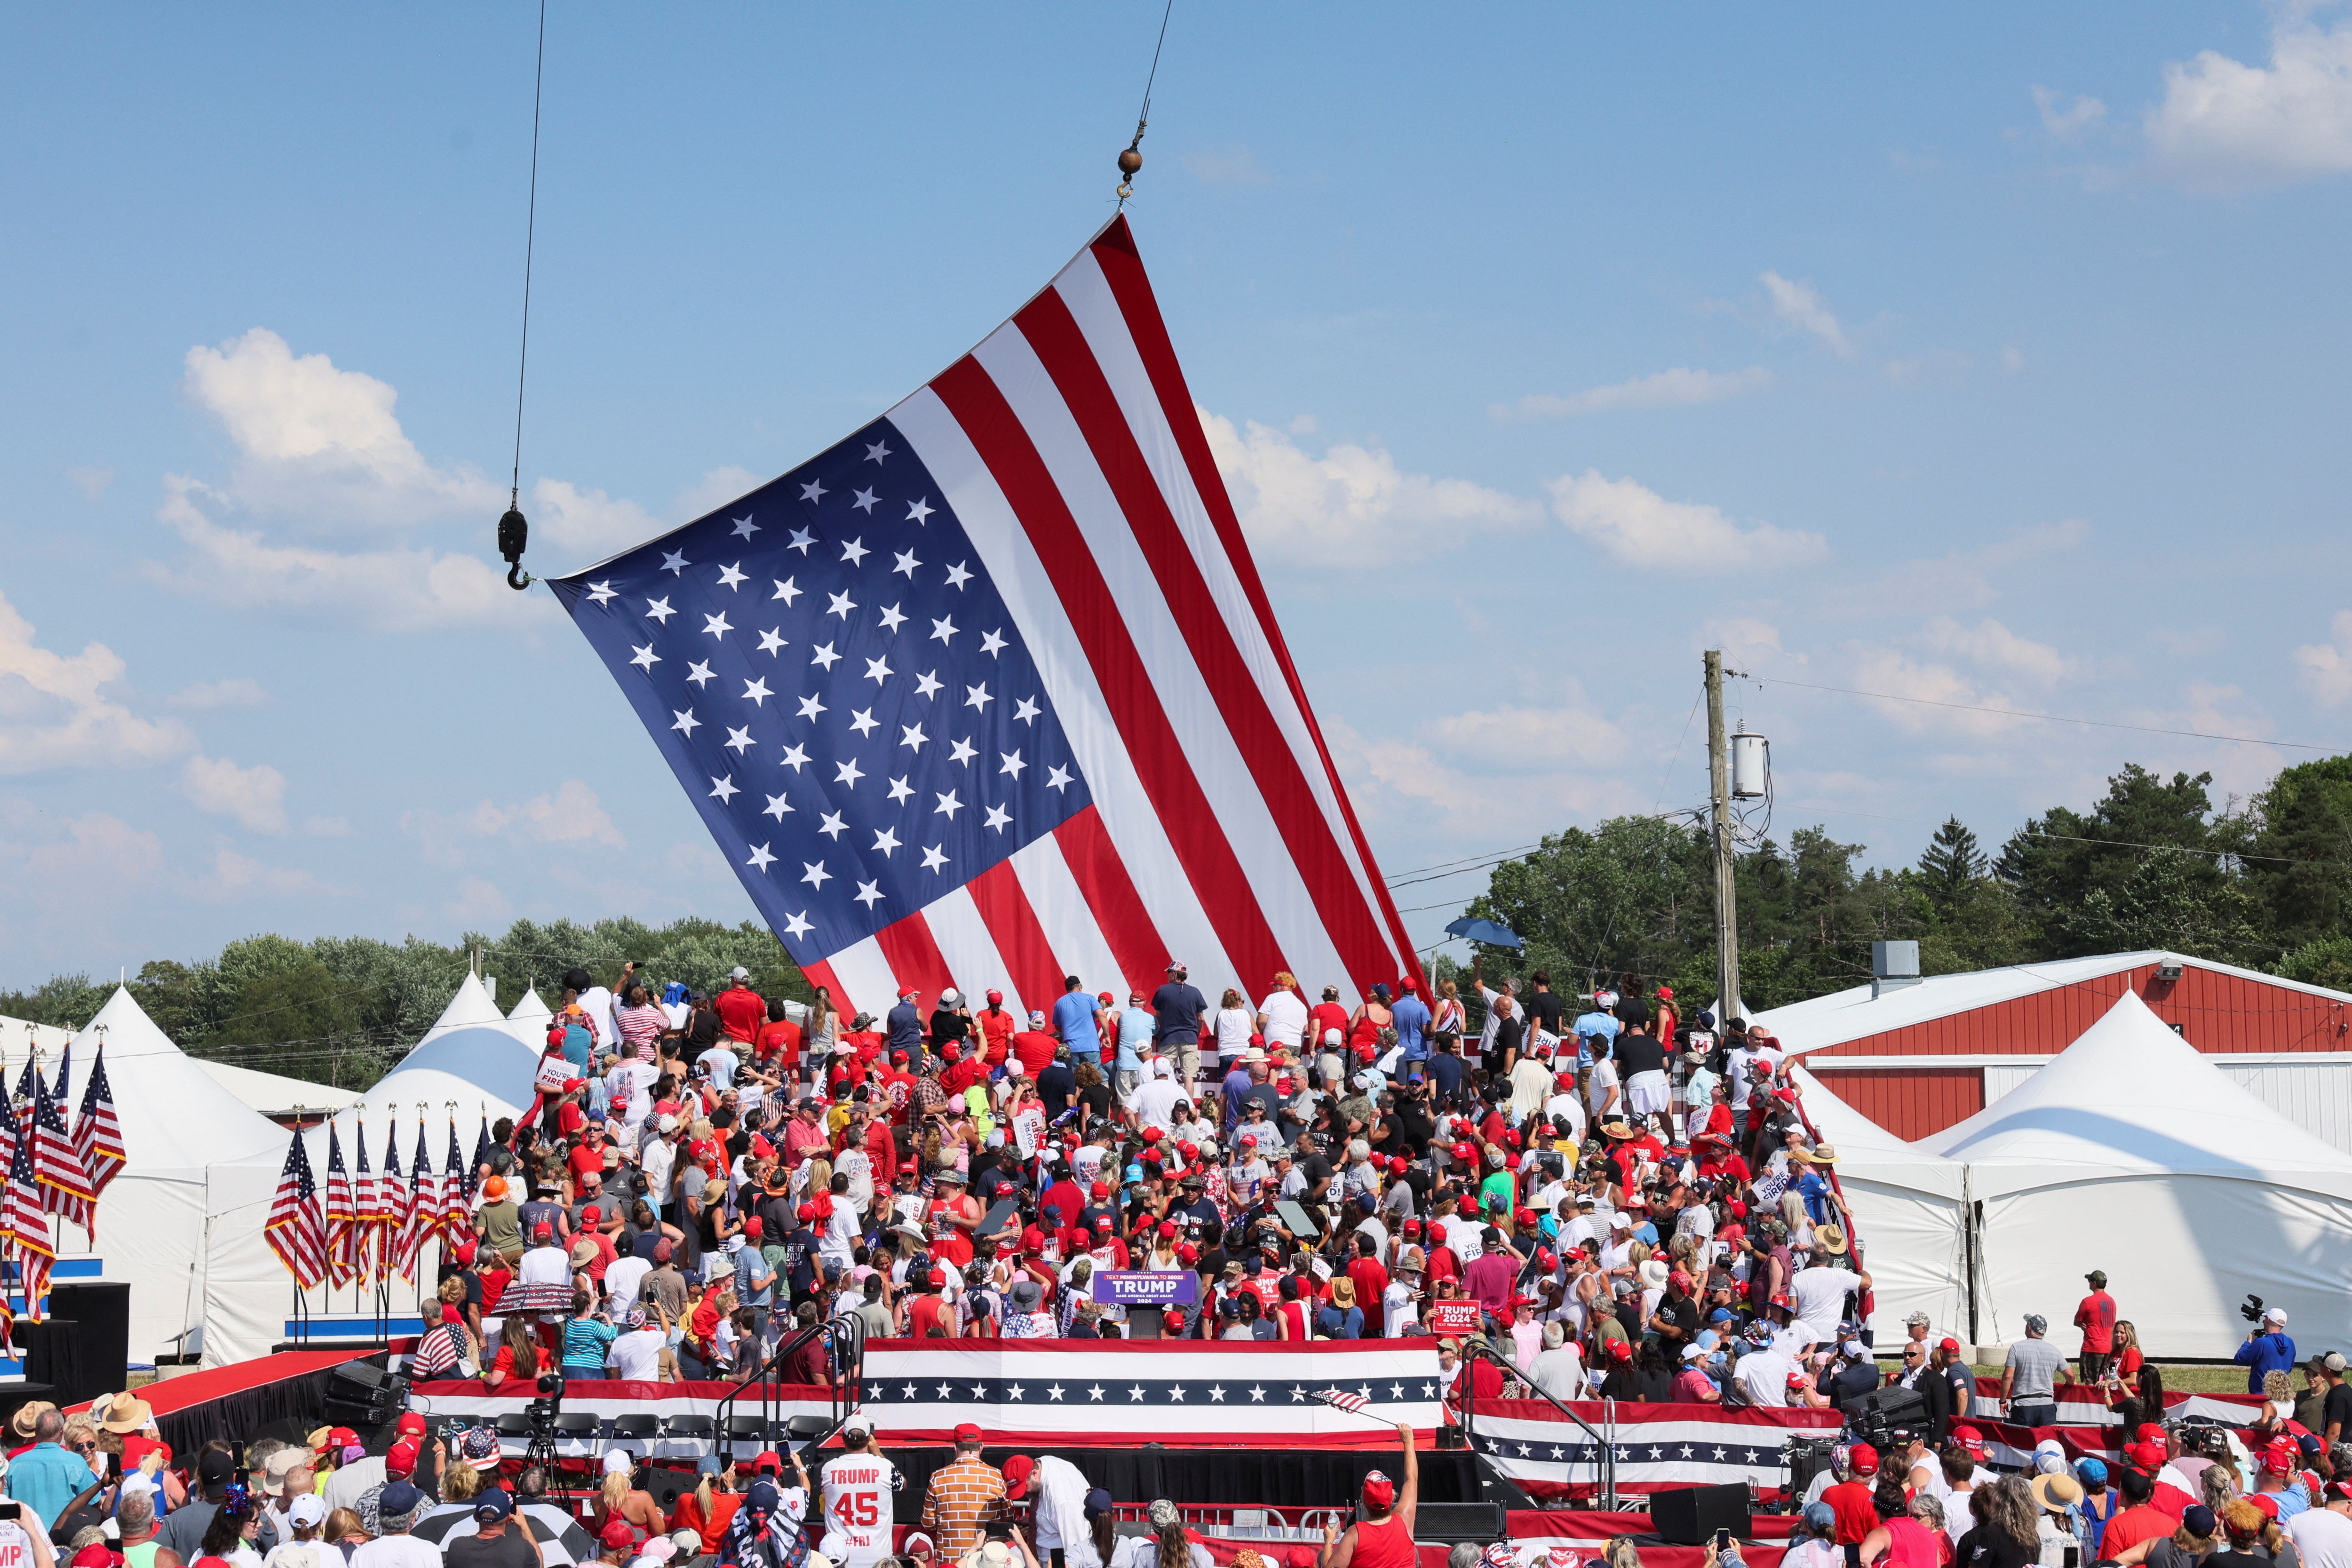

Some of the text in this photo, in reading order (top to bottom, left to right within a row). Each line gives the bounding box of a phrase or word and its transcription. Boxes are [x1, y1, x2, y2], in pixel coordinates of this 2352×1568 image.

[1536, 1035, 1557, 1050] FIRE
[547, 1068, 571, 1080] YOU'RE
[1024, 1122, 1035, 1150] YOU'RE
[1761, 1170, 1786, 1194] YOU'RE
[787, 1252, 801, 1262] 2024
[1833, 1258, 1846, 1268] The
[1112, 1281, 1177, 1293] TRUMP
[1438, 1305, 1476, 1314] TRUMP
[1443, 1314, 1470, 1323] 2024
[830, 1469, 880, 1484] TRUMP
[834, 1492, 878, 1526] 45
[844, 1535, 870, 1547] #FRJ
